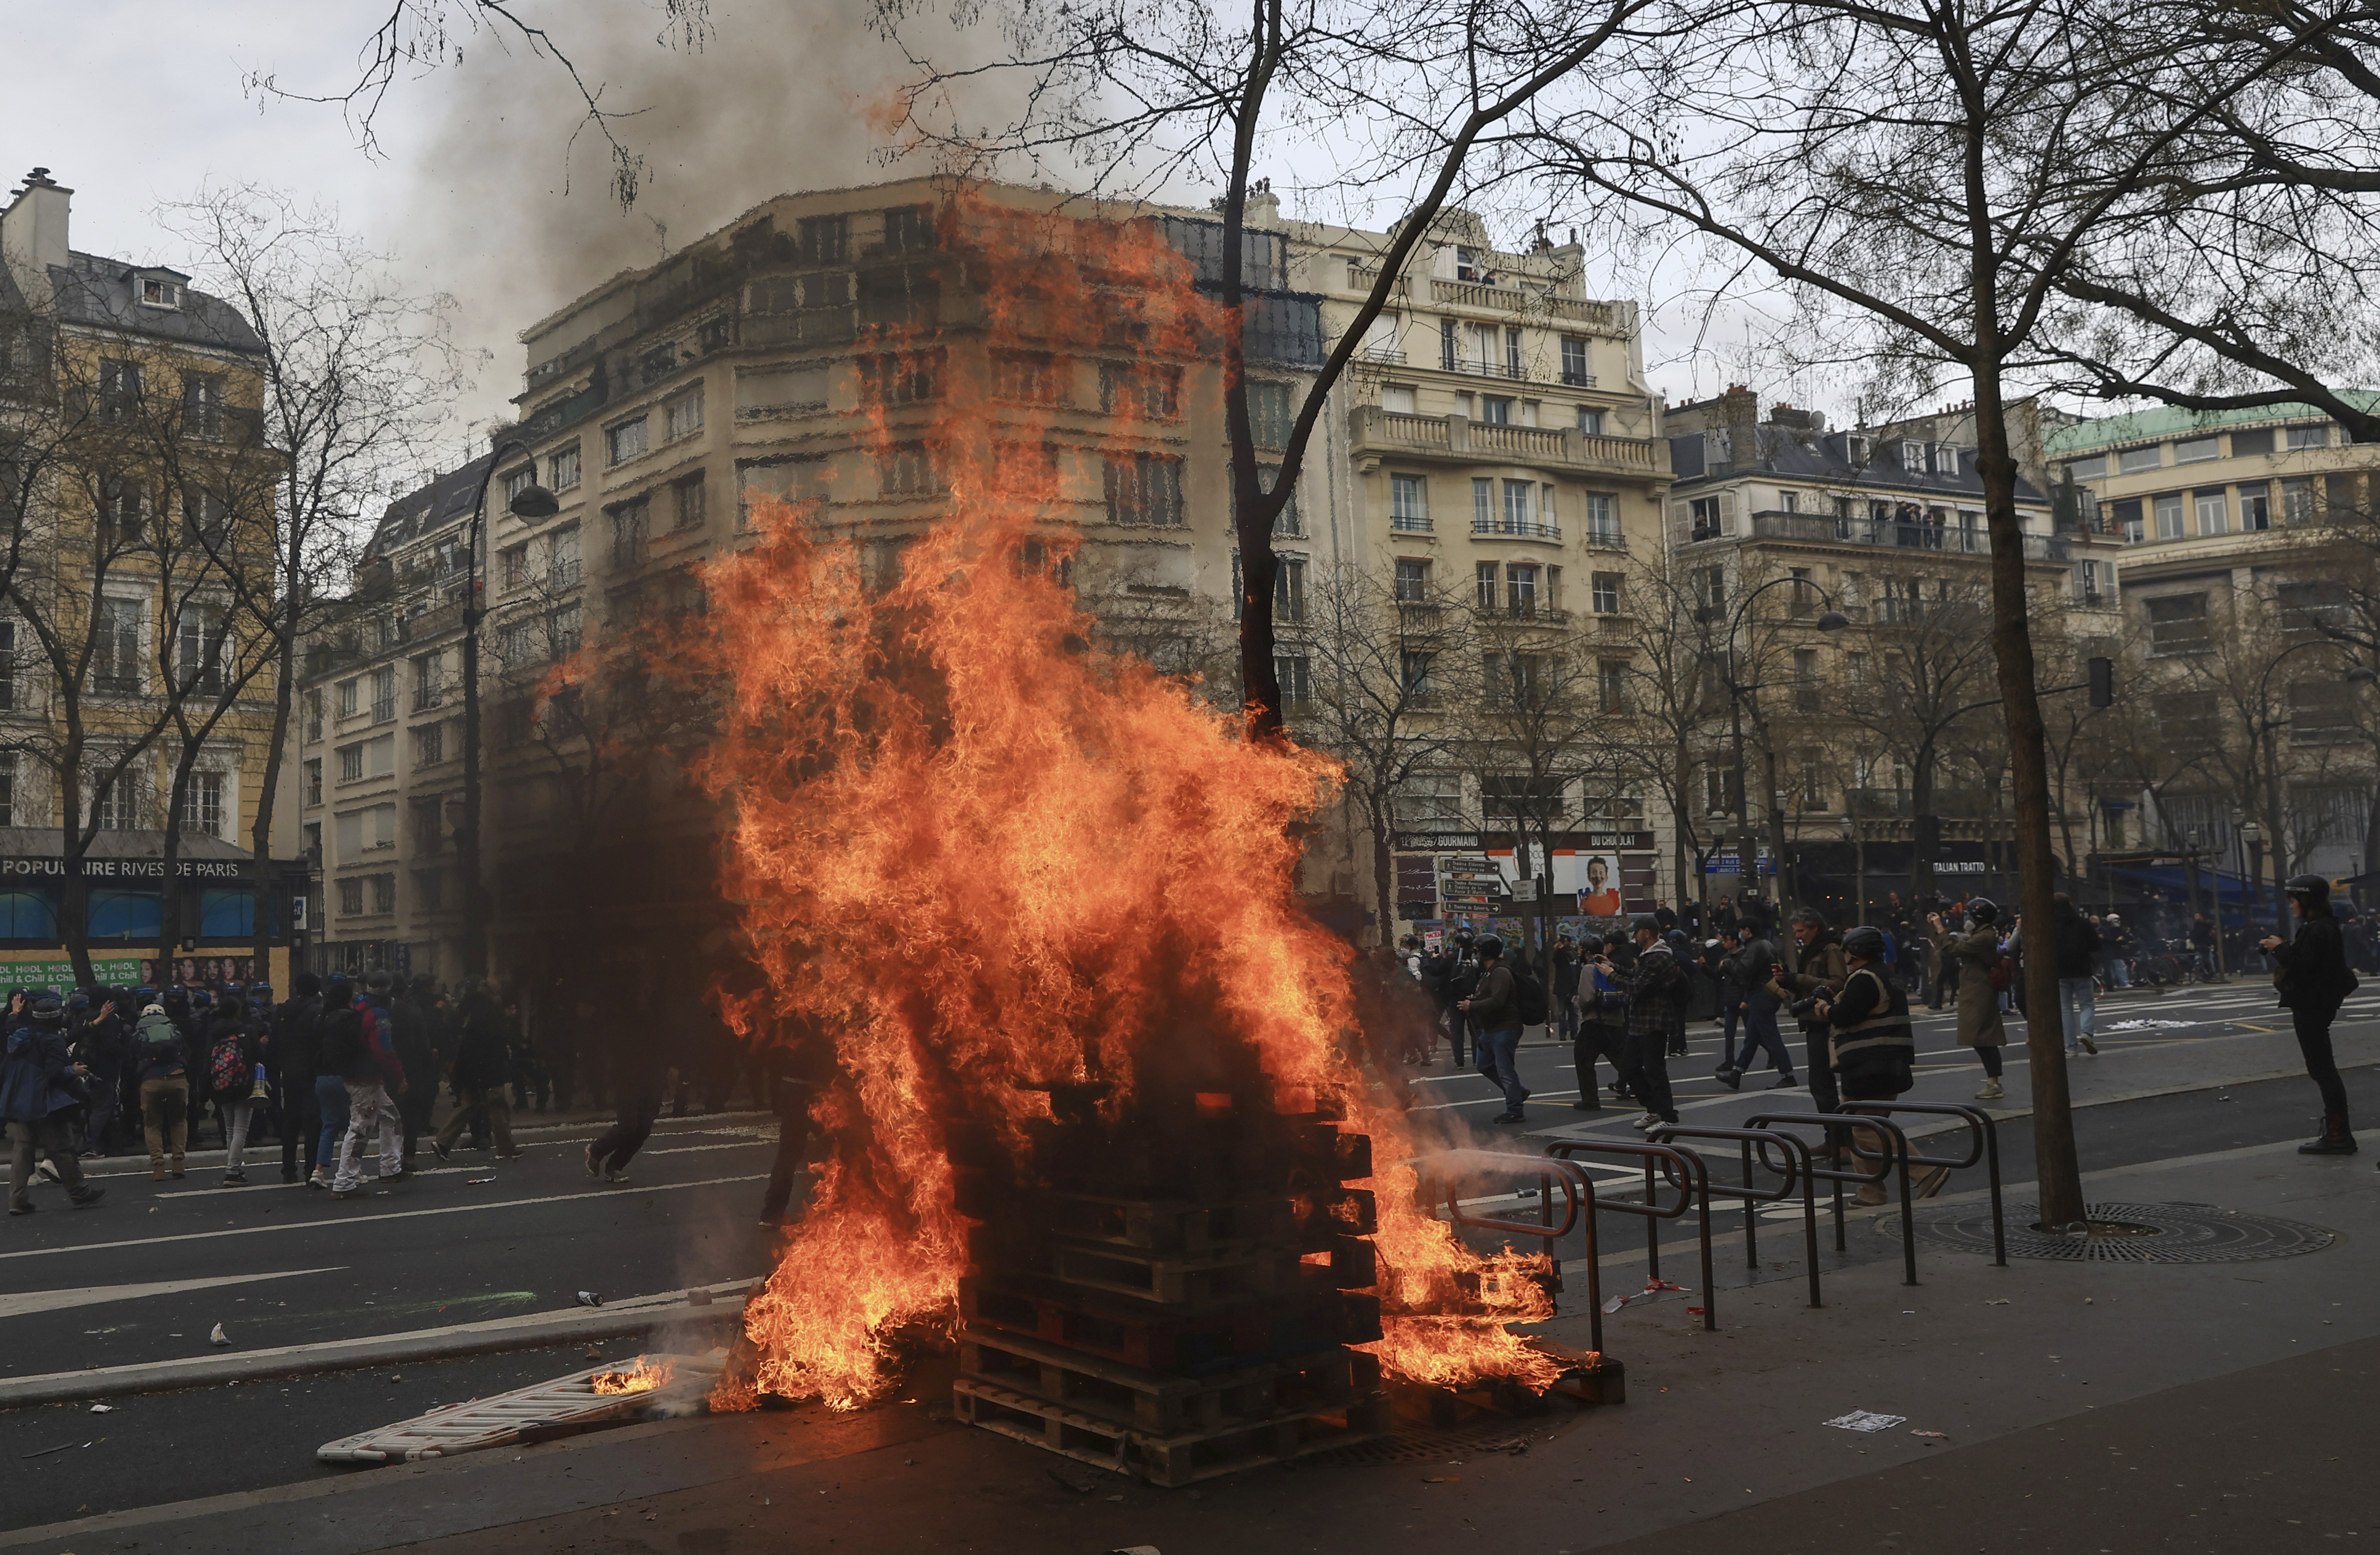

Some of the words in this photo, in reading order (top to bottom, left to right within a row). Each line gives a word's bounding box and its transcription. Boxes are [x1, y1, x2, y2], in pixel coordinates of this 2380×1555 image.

[1438, 835, 1478, 846] GOURMAND
[1592, 835, 1600, 846] DU
[2, 860, 115, 876] POPULIRE
[121, 863, 164, 876] RIVES
[196, 864, 239, 877] PARIS
[1933, 862, 1959, 872] ITALIAN
[0, 974, 13, 983] hill
[25, 974, 45, 982] Chill
[95, 973, 107, 981] hill
[118, 971, 137, 979] Chill
